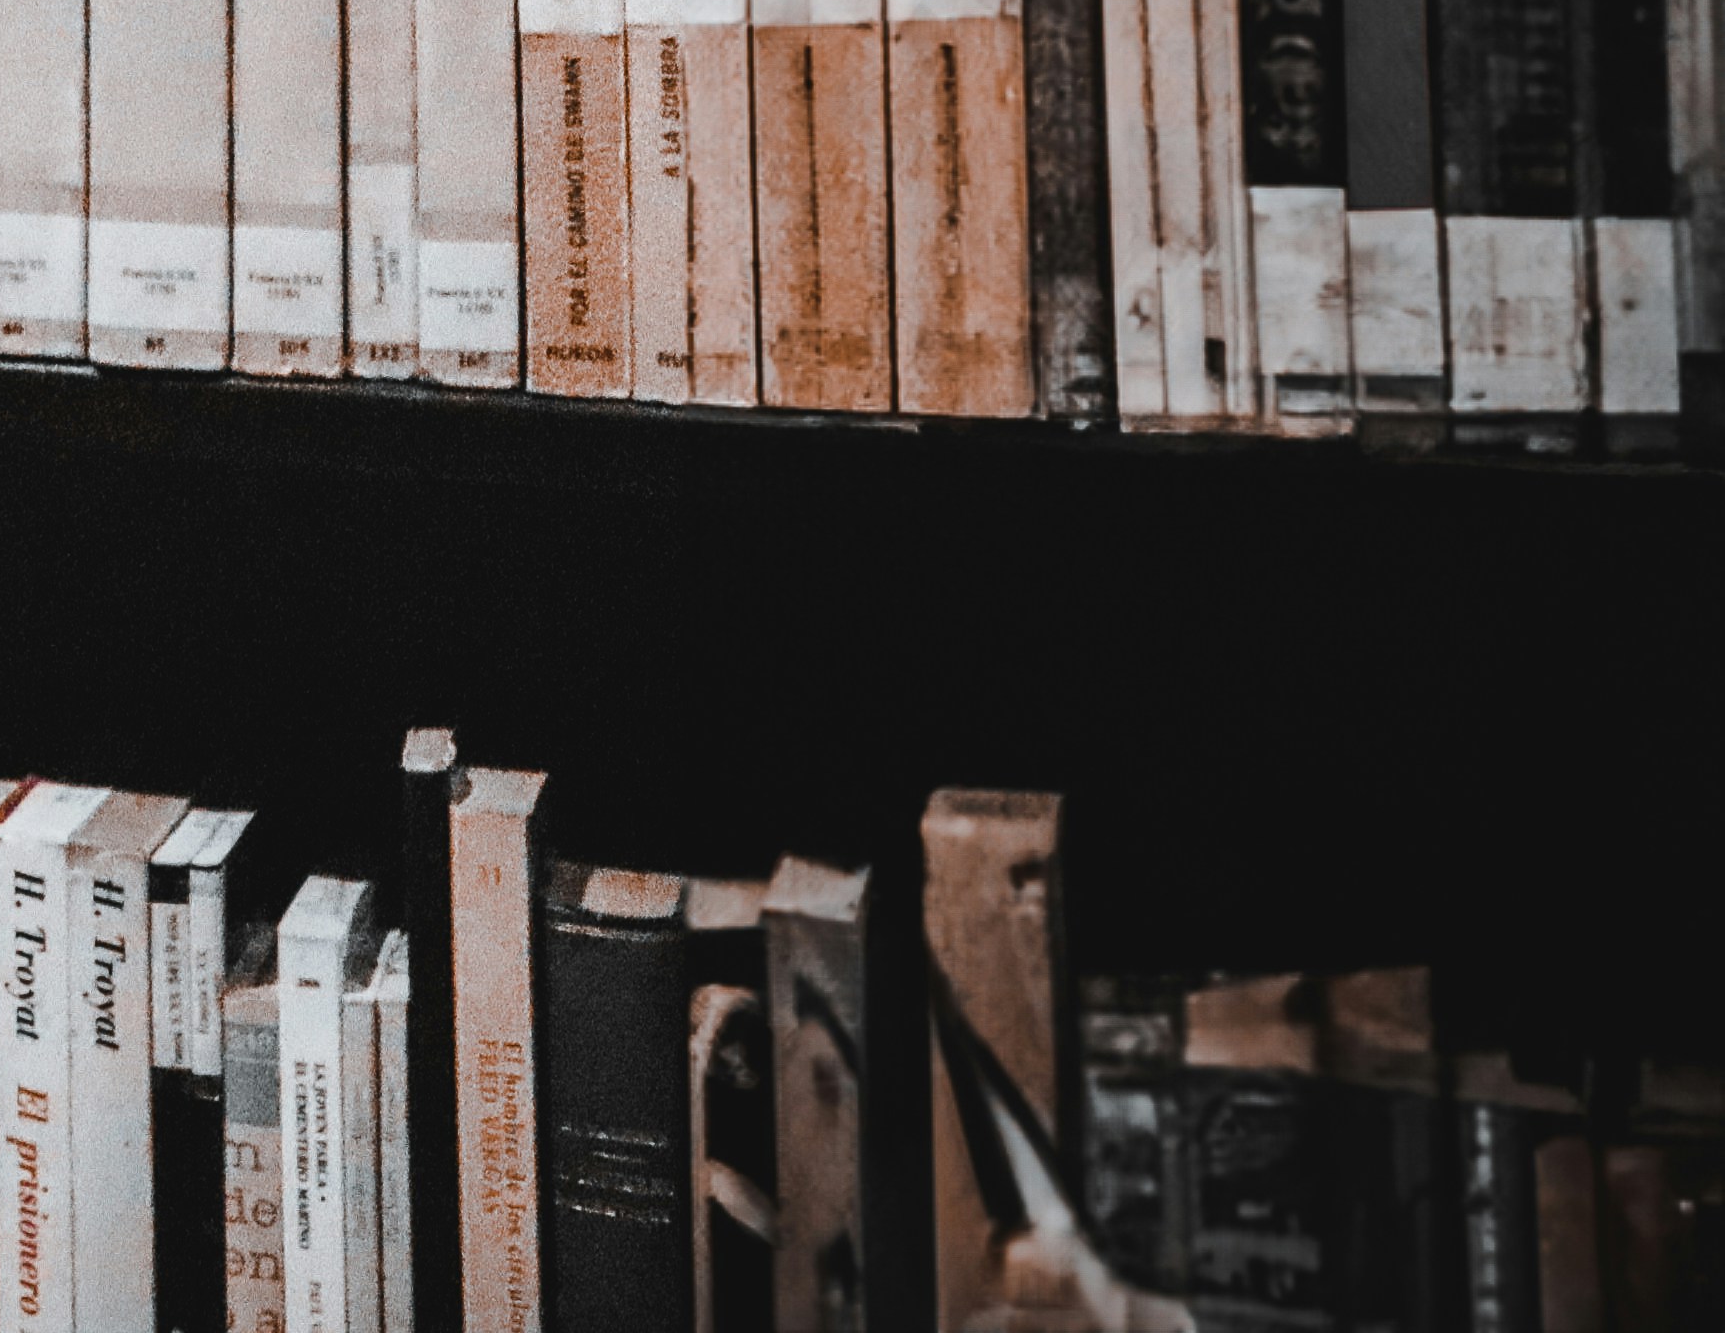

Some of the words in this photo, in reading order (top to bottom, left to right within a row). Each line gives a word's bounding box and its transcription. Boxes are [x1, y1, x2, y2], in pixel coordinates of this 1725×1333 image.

[659, 36, 680, 123] SOMBRA
[563, 136, 585, 162] DE
[562, 169, 587, 250] CAMINO
[564, 259, 587, 282] EL
[563, 287, 588, 327] POR
[14, 868, 46, 909] H.
[92, 878, 125, 918] H.
[4, 927, 47, 1041] Troyat
[80, 935, 127, 1052] Troyat
[17, 1086, 49, 1125] El
[480, 1115, 503, 1215] VARGAS
[5, 1135, 48, 1317] prisionero
